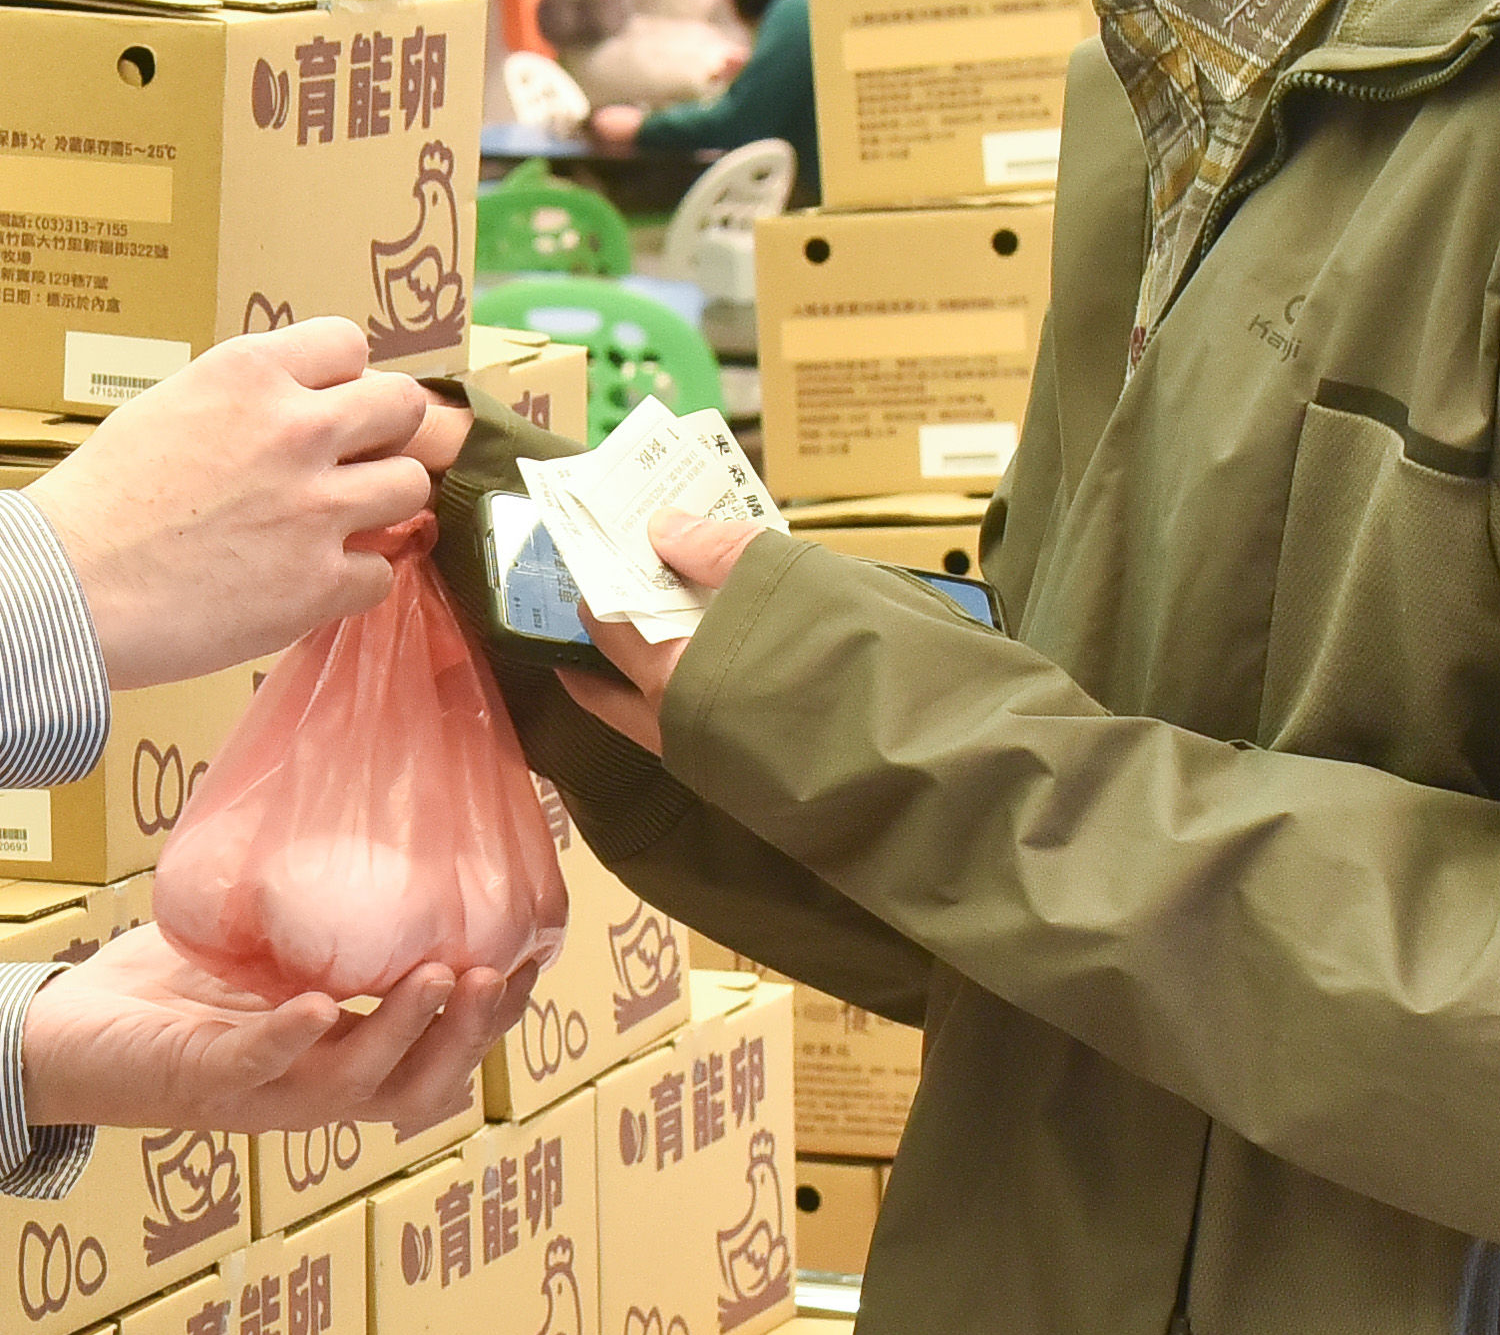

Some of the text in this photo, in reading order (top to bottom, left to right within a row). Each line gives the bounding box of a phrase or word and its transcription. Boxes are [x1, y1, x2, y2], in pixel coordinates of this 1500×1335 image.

[295, 26, 447, 146] 育能卵
[650, 1035, 765, 1171] 育能卵
[434, 1136, 564, 1289] 育能卵
